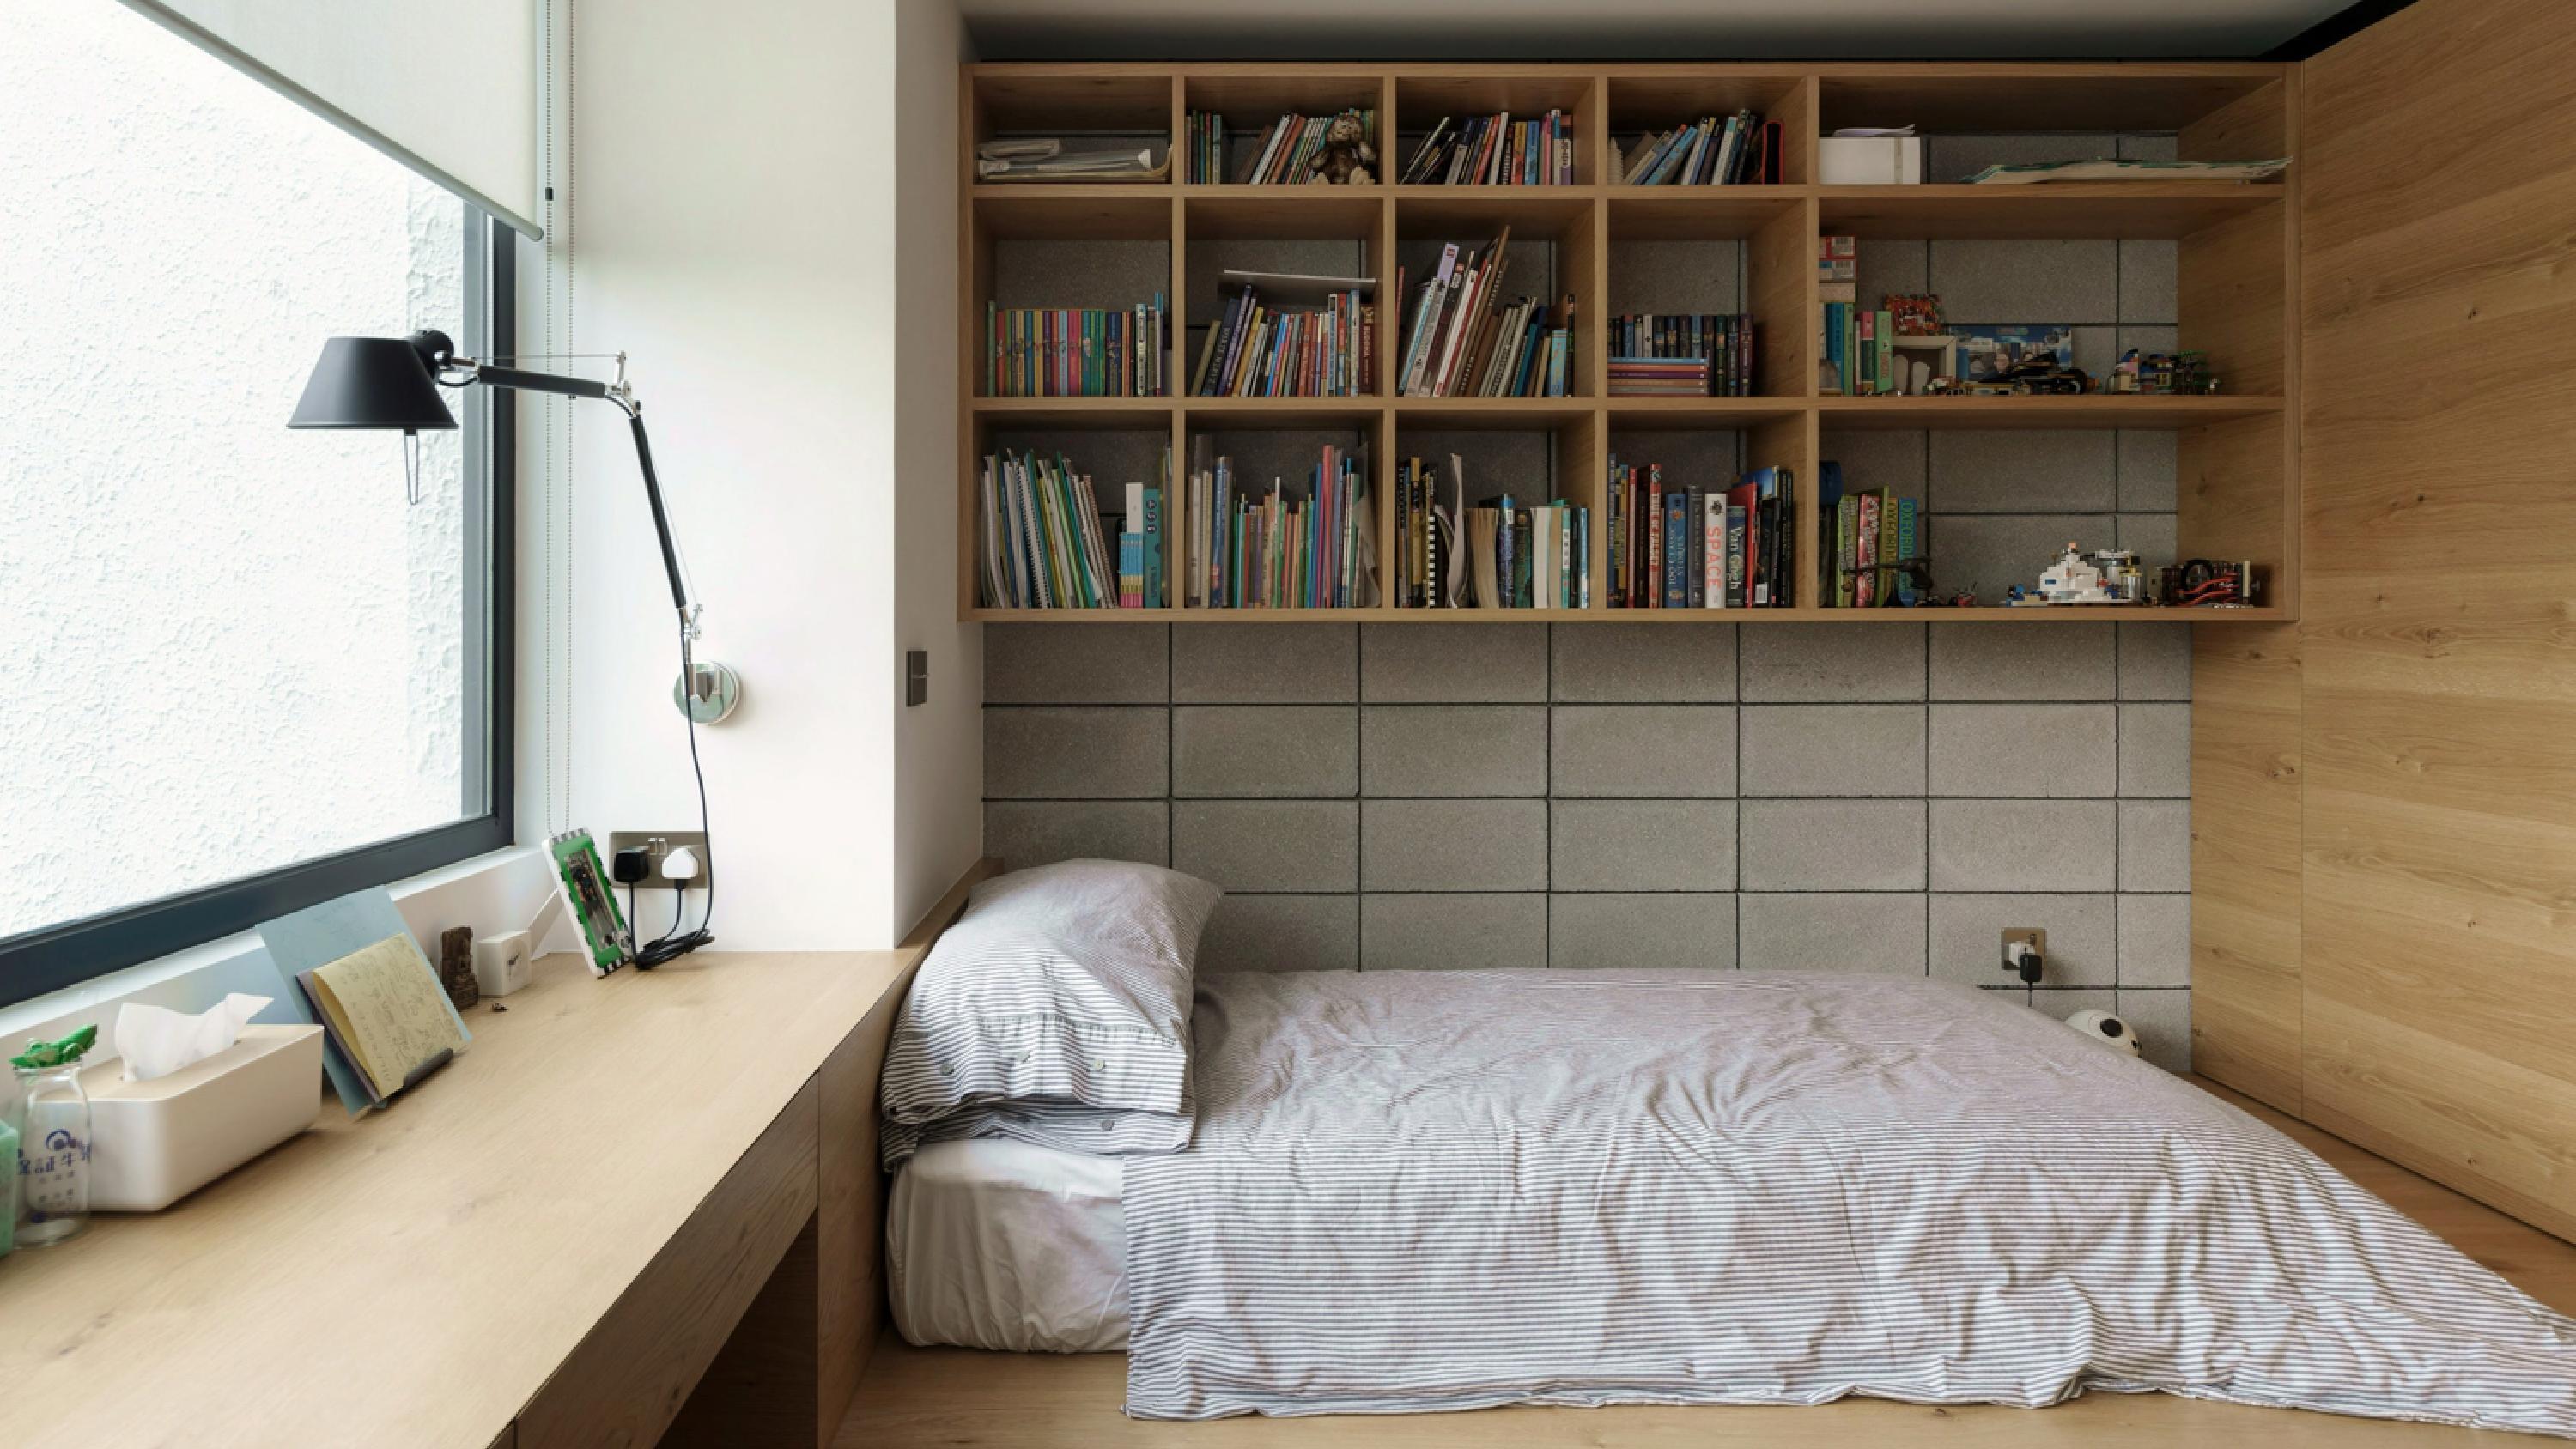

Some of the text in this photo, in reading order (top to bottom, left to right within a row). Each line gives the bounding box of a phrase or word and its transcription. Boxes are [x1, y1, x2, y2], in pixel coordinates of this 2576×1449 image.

[1730, 526, 1744, 552] Van
[1900, 501, 1914, 556] OXFORD
[1706, 526, 1722, 590] SPACE
